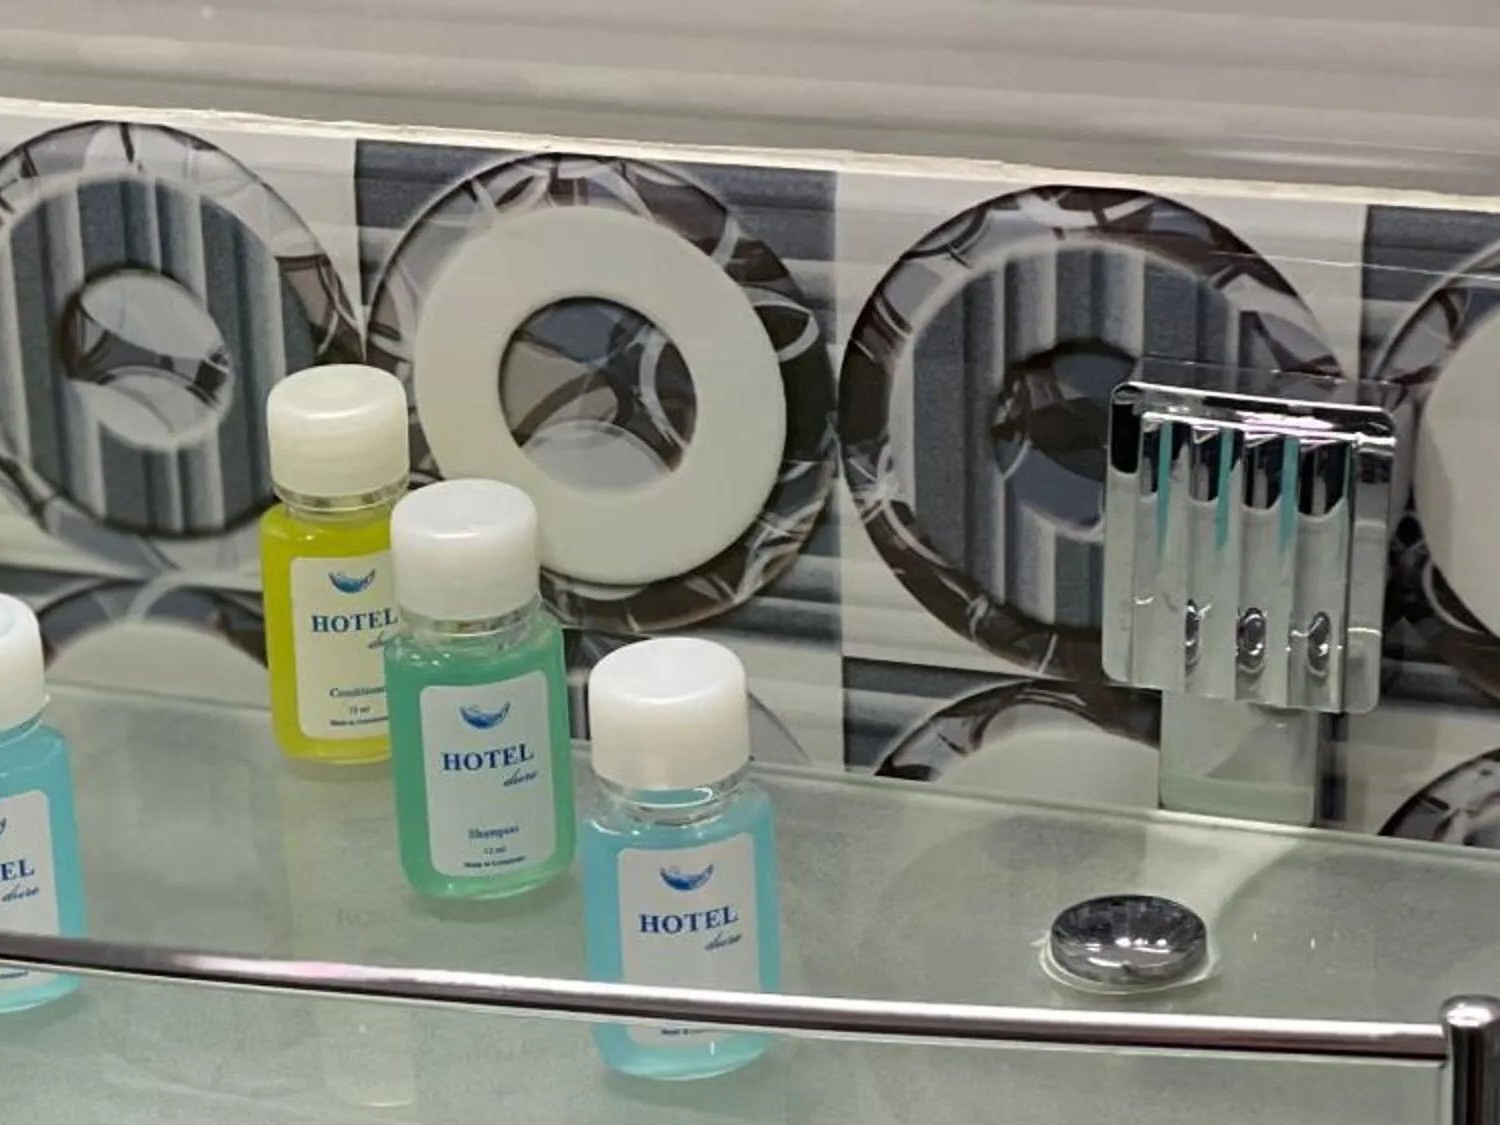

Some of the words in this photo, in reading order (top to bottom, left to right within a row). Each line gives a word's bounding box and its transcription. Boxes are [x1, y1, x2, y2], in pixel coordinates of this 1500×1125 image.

[311, 608, 399, 633] HOTEL
[442, 743, 535, 771] HOTEL
[641, 905, 739, 934] HOTEL
